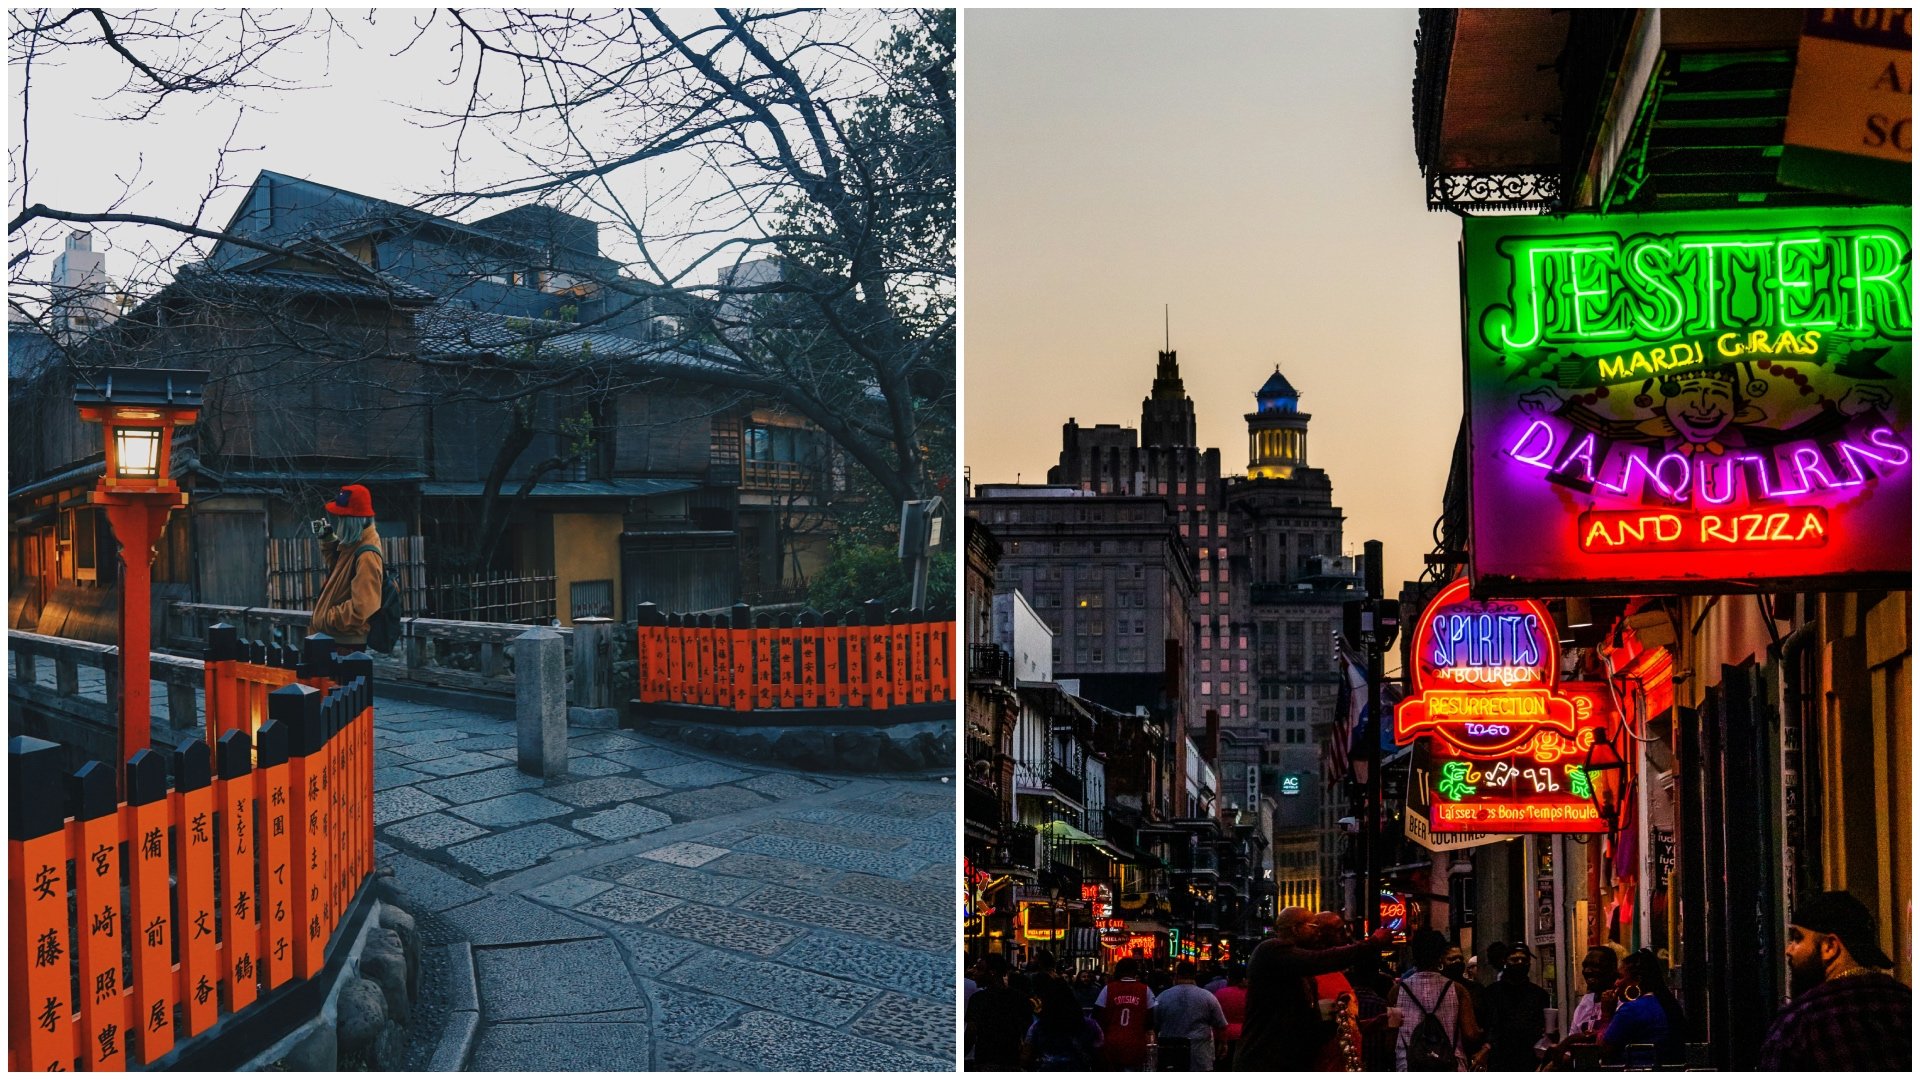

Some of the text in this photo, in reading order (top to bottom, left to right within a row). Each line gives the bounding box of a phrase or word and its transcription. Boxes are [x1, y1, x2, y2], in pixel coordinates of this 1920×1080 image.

[1497, 231, 1912, 350] JESTER
[1598, 329, 1821, 380] MARDI GRAS
[1585, 514, 1682, 547] AND
[1431, 613, 1540, 668] SPIRITS
[1453, 666, 1541, 686] BOURBON
[1429, 696, 1545, 716] RESURRECTION
[1283, 777, 1298, 786] AC
[1498, 804, 1525, 820] Bons
[1526, 804, 1563, 821] Temps
[1409, 814, 1427, 841] BEER
[142, 827, 169, 1033] 備前屋
[1120, 1008, 1130, 1027] 0
